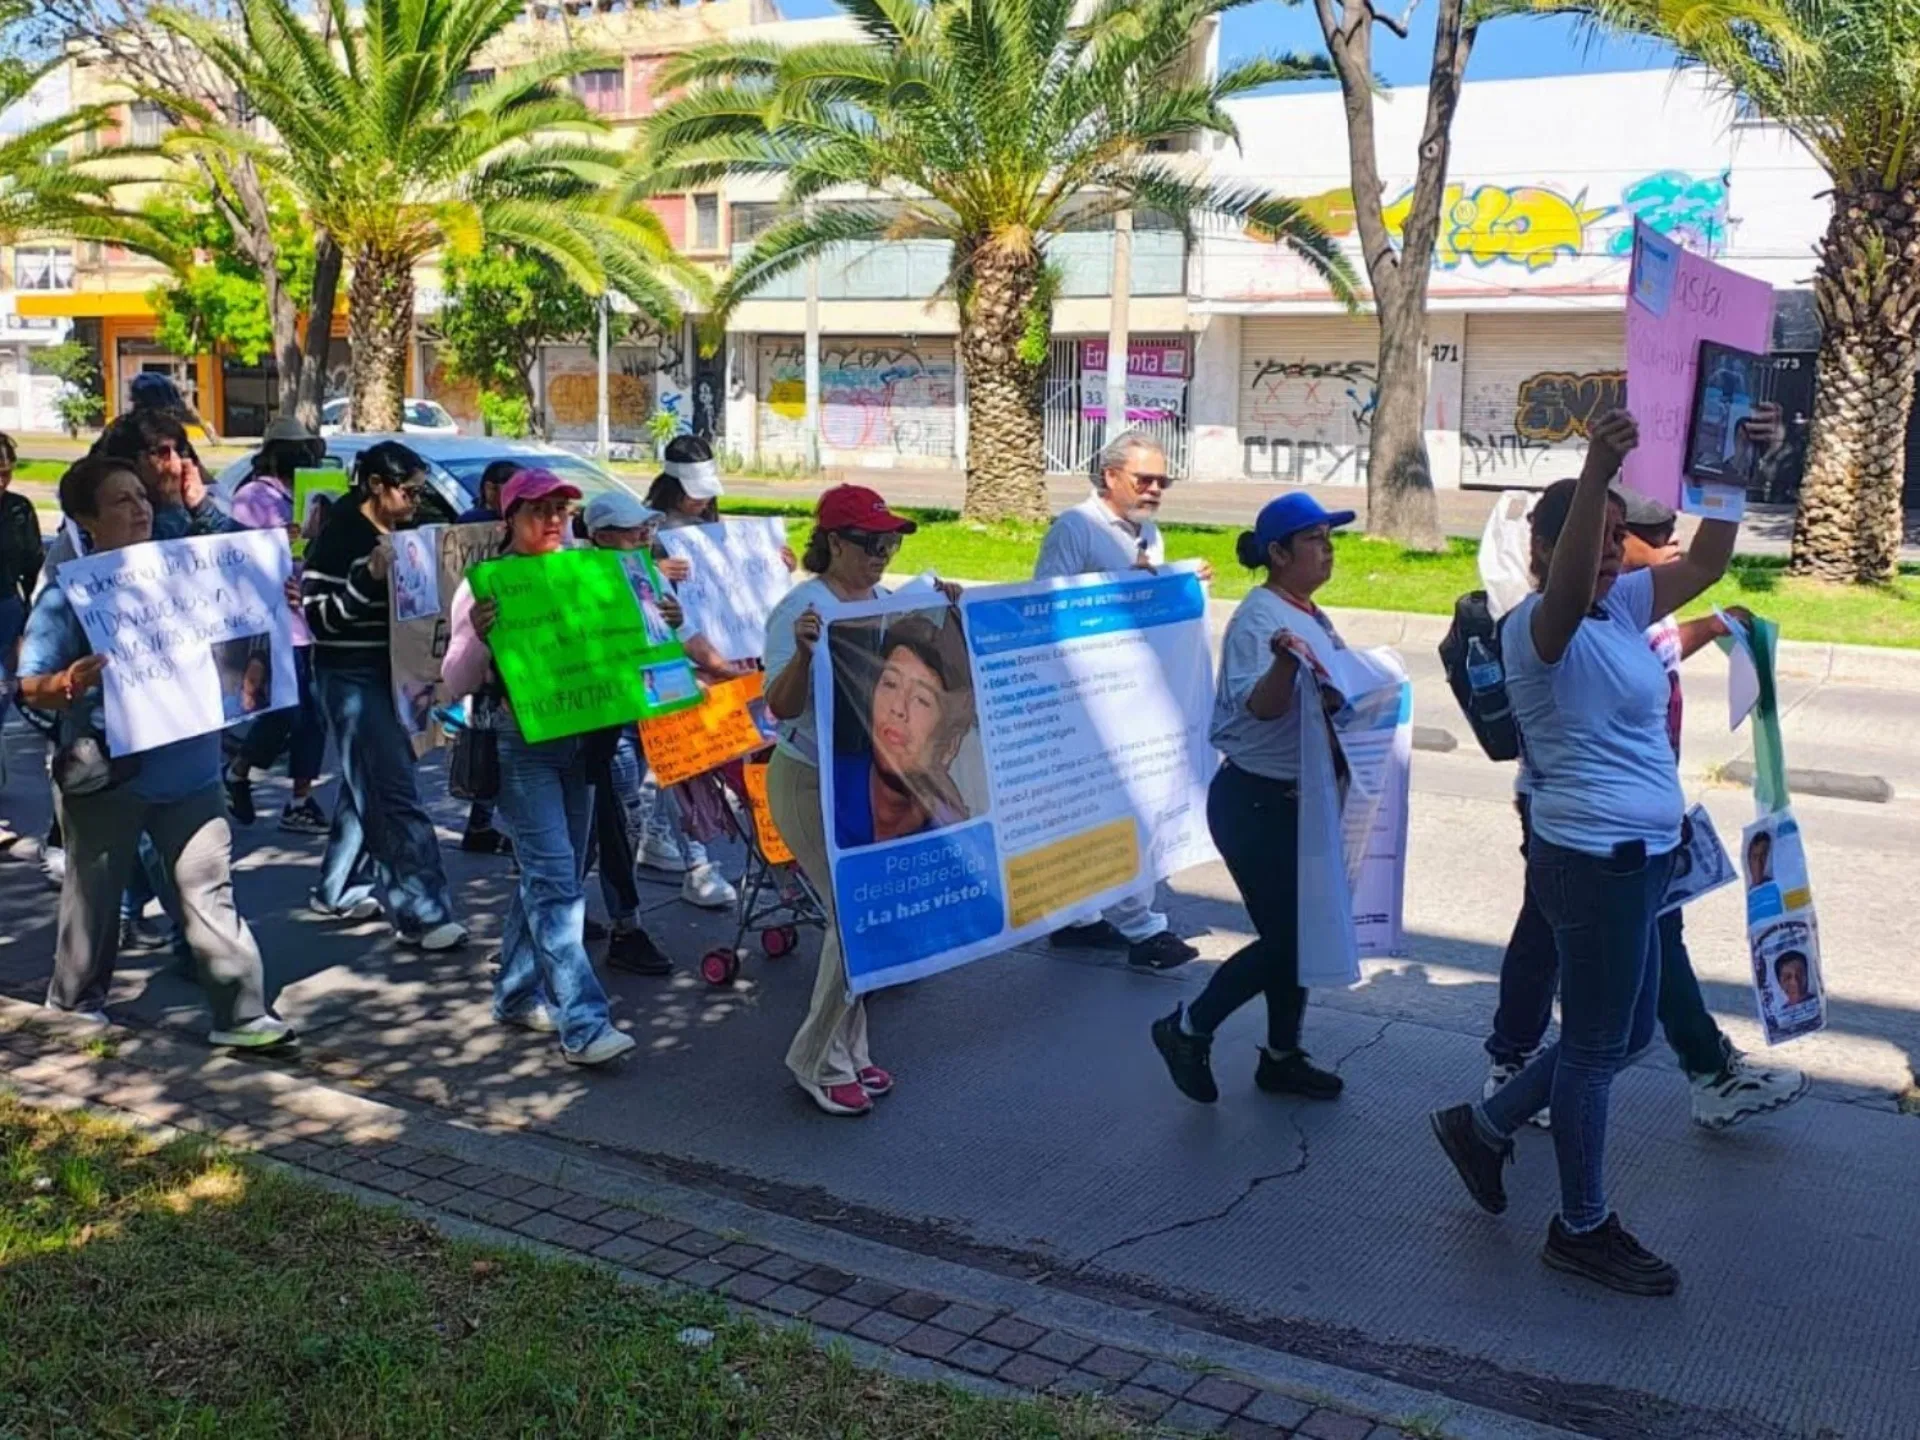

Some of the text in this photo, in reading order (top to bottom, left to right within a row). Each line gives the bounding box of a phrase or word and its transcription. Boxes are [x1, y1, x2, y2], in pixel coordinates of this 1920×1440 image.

[1085, 343, 1104, 369] En
[1431, 345, 1458, 362] 471
[885, 841, 963, 873] Persona
[855, 907, 892, 934] ¿La
[896, 894, 930, 921] has
[933, 879, 987, 906] visto?
